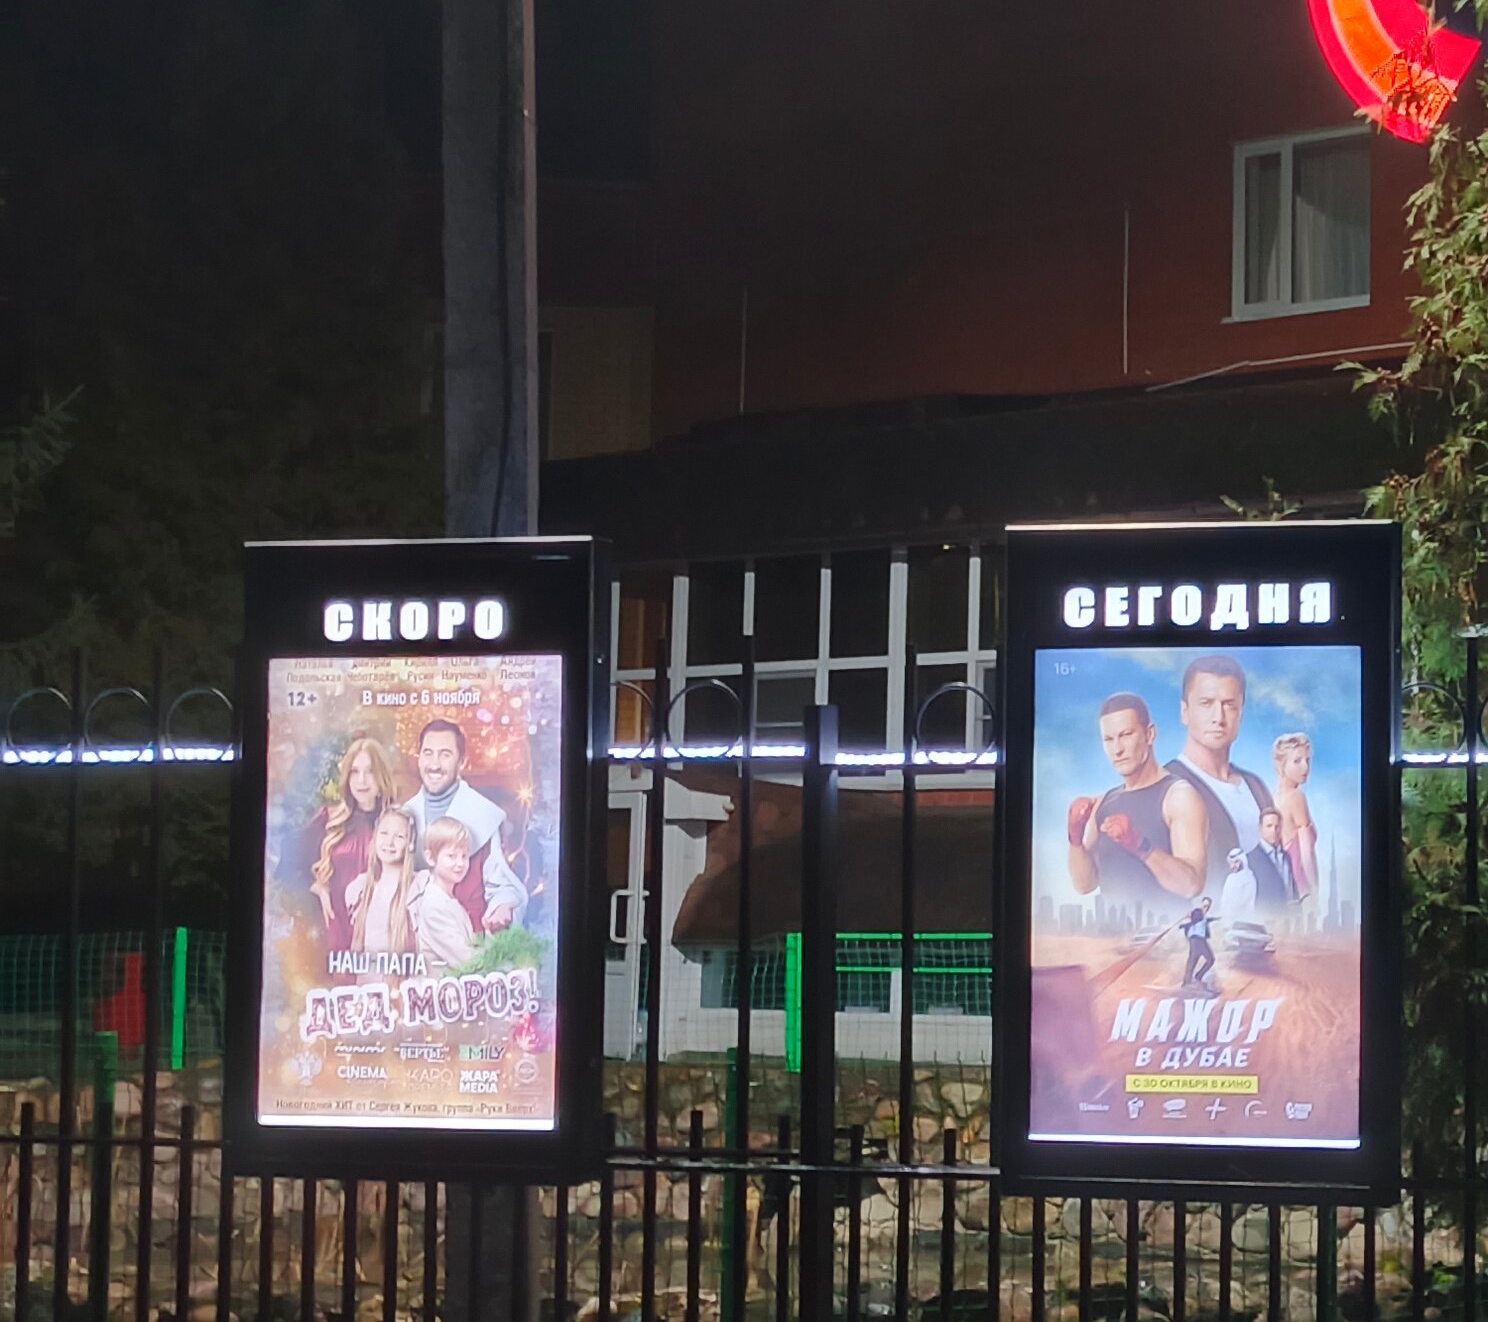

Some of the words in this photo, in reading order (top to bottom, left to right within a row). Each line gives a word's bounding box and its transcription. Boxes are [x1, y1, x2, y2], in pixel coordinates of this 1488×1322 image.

[1064, 582, 1331, 631] СЕГОДНЯ
[324, 601, 504, 642] СКОРО
[1053, 662, 1077, 676] 16+
[287, 691, 318, 707] 12+
[362, 691, 373, 706] В
[377, 693, 406, 706] кино
[421, 690, 430, 705] 6
[434, 689, 481, 708] ноября
[329, 950, 370, 975] НАШ
[376, 952, 427, 976] ПАПА
[303, 986, 393, 1038] ДЕД
[404, 969, 540, 1026] МОРОЗ!
[1108, 996, 1285, 1044] МАЖОР
[1135, 1047, 1152, 1067] В
[1160, 1045, 1251, 1070] ДУБАЕ
[337, 1066, 388, 1079] CINEMA
[459, 1070, 498, 1082] ЖАРА
[459, 1082, 499, 1094] MEDIA
[1159, 1078, 1210, 1089] ОКТЯБРЯ
[1220, 1079, 1253, 1090] КИНО
